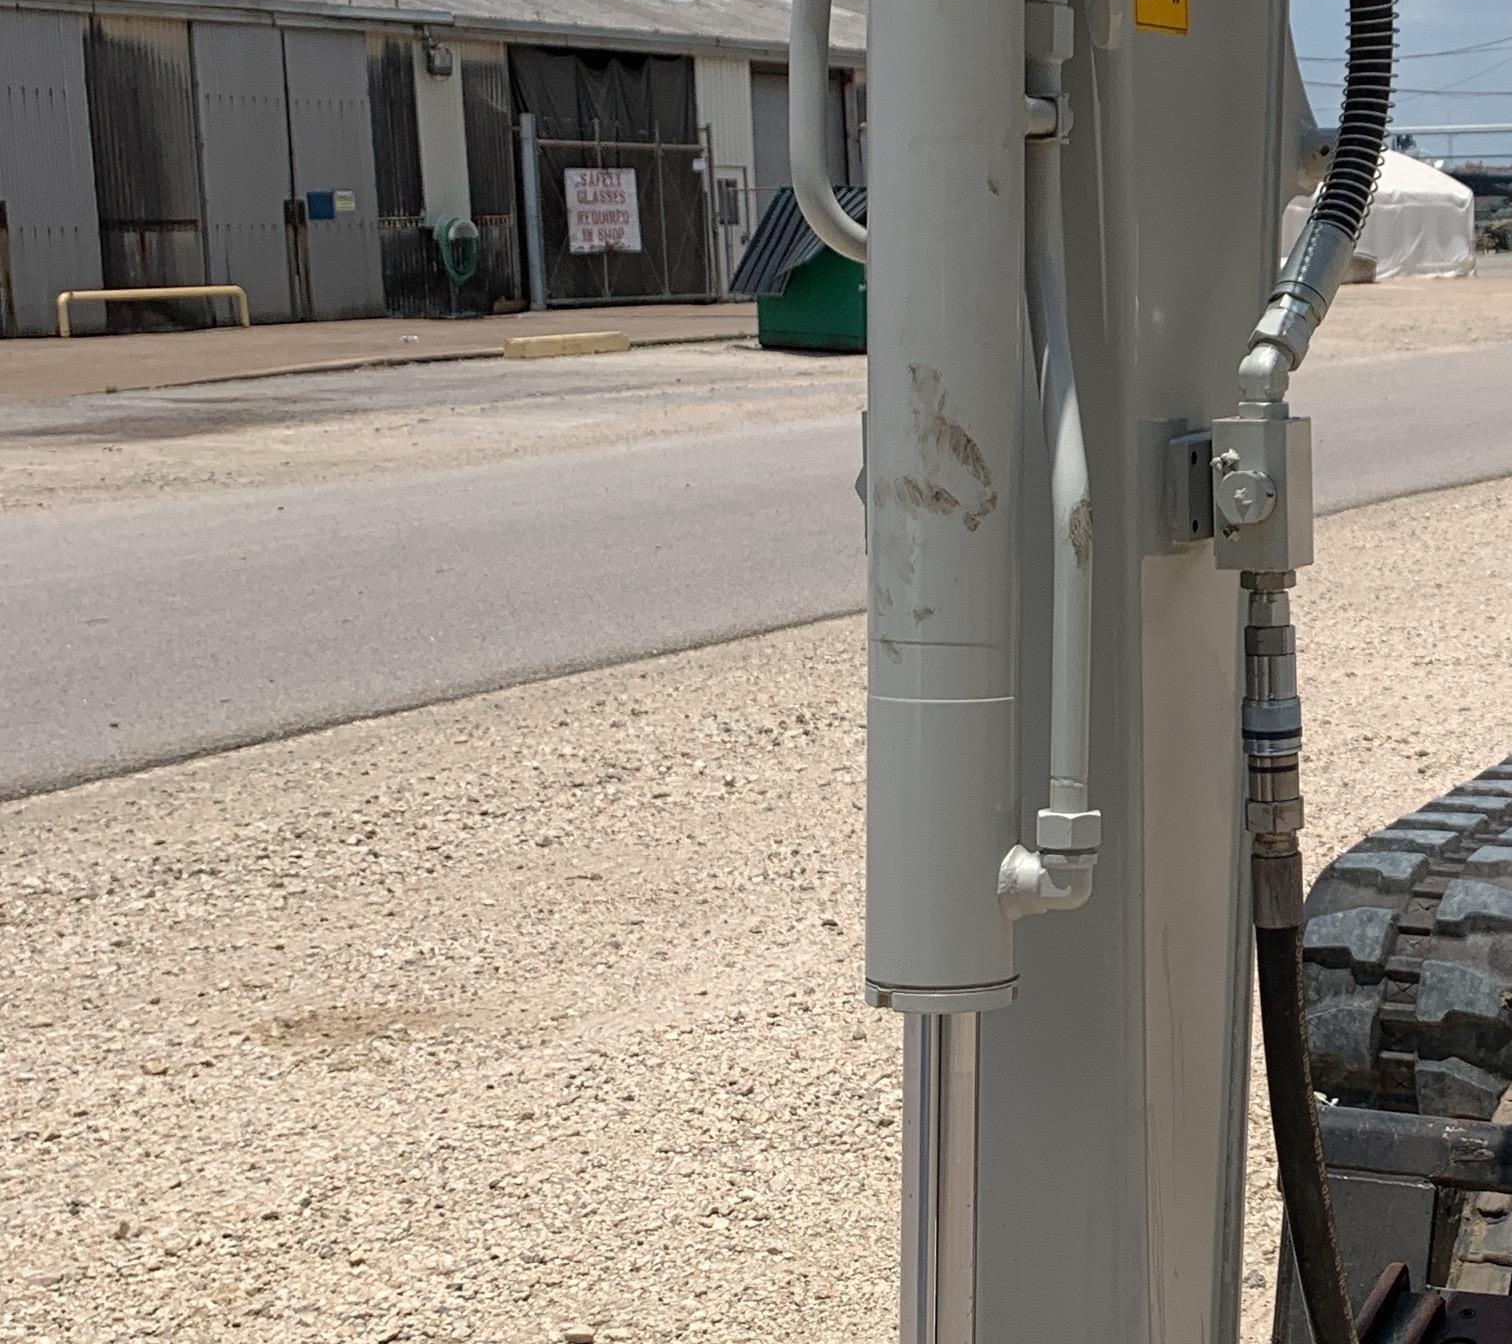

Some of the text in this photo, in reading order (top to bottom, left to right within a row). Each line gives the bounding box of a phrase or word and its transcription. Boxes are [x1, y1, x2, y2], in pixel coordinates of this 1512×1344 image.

[580, 171, 622, 188] SAFETY
[576, 189, 627, 205] GLASSES
[576, 208, 630, 226] REQUIRED
[581, 226, 626, 243] IN SHOP
